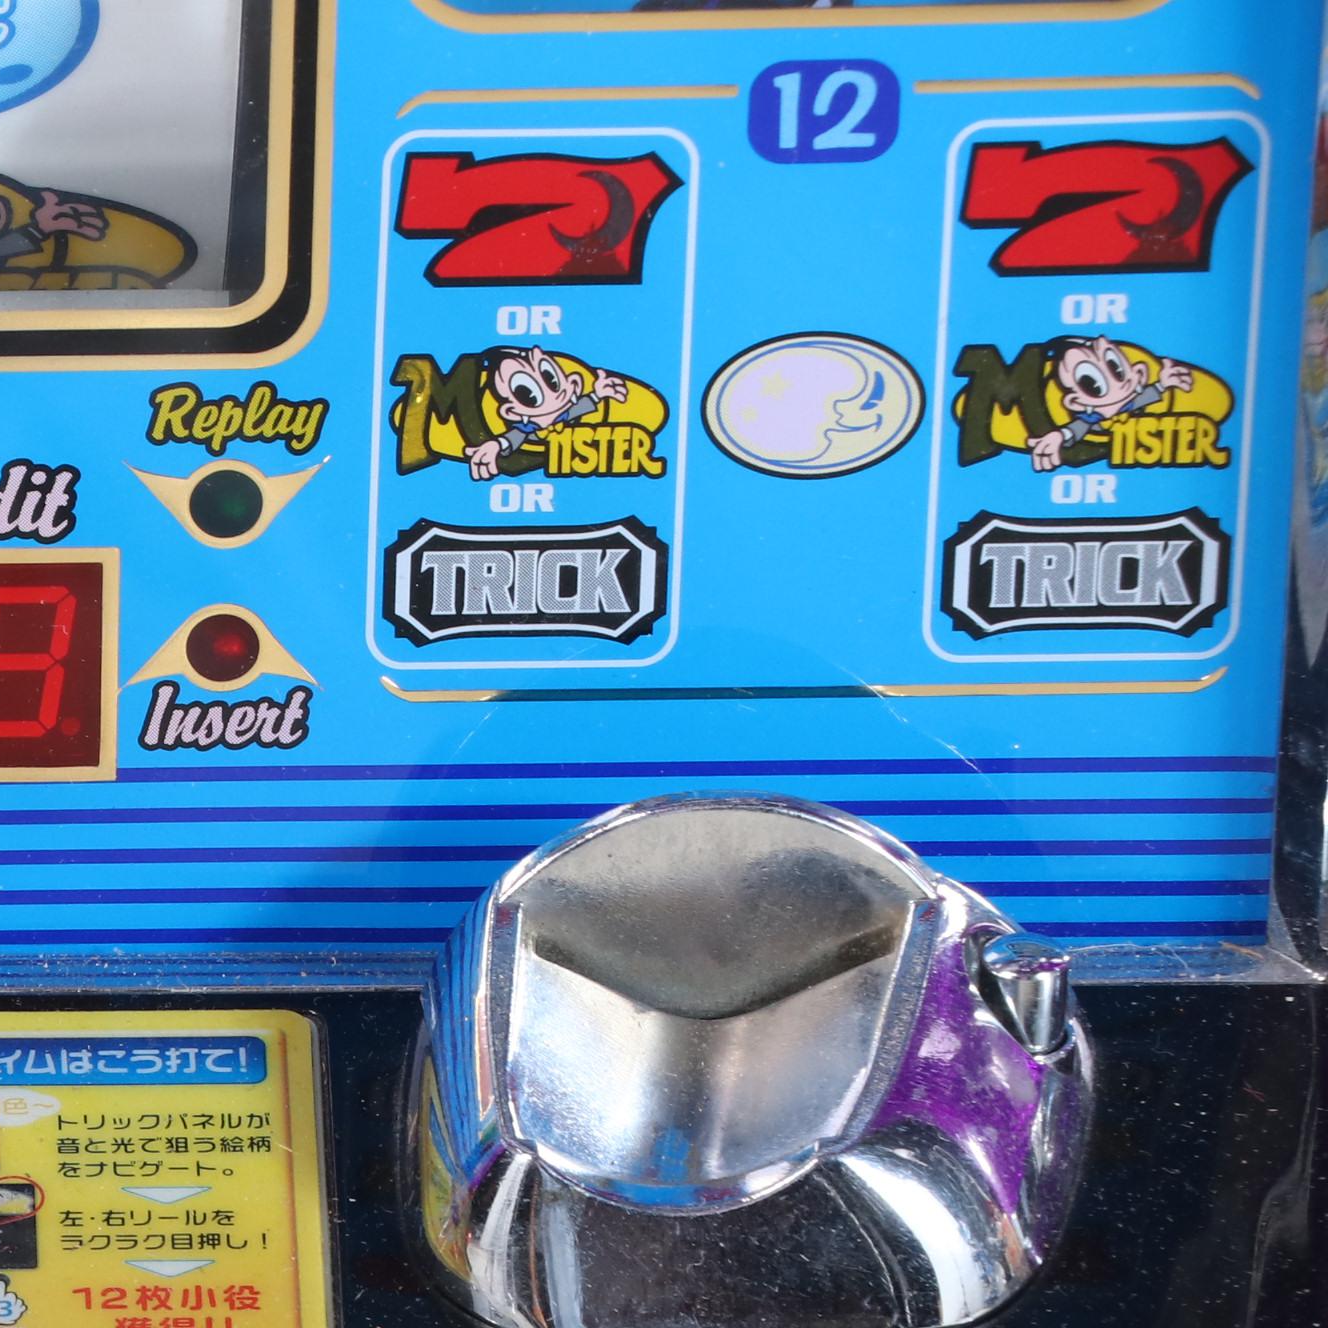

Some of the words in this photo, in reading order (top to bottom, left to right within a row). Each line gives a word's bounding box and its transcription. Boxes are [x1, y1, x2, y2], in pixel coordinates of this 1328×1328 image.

[772, 70, 880, 152] 12
[394, 151, 684, 287] 7
[961, 137, 1254, 278] 7
[496, 304, 562, 336] OR
[1060, 293, 1129, 326] OR
[148, 381, 328, 455] Replay
[489, 482, 556, 514] OR
[1050, 473, 1118, 506] OR
[420, 547, 636, 616] TRICK
[979, 540, 1200, 609] TRICK
[139, 681, 313, 750] Insert
[57, 1112, 272, 1131] トリックパネルが
[57, 1136, 272, 1154] 音と光で狙う絵柄
[72, 1285, 262, 1311] 12枚小役
